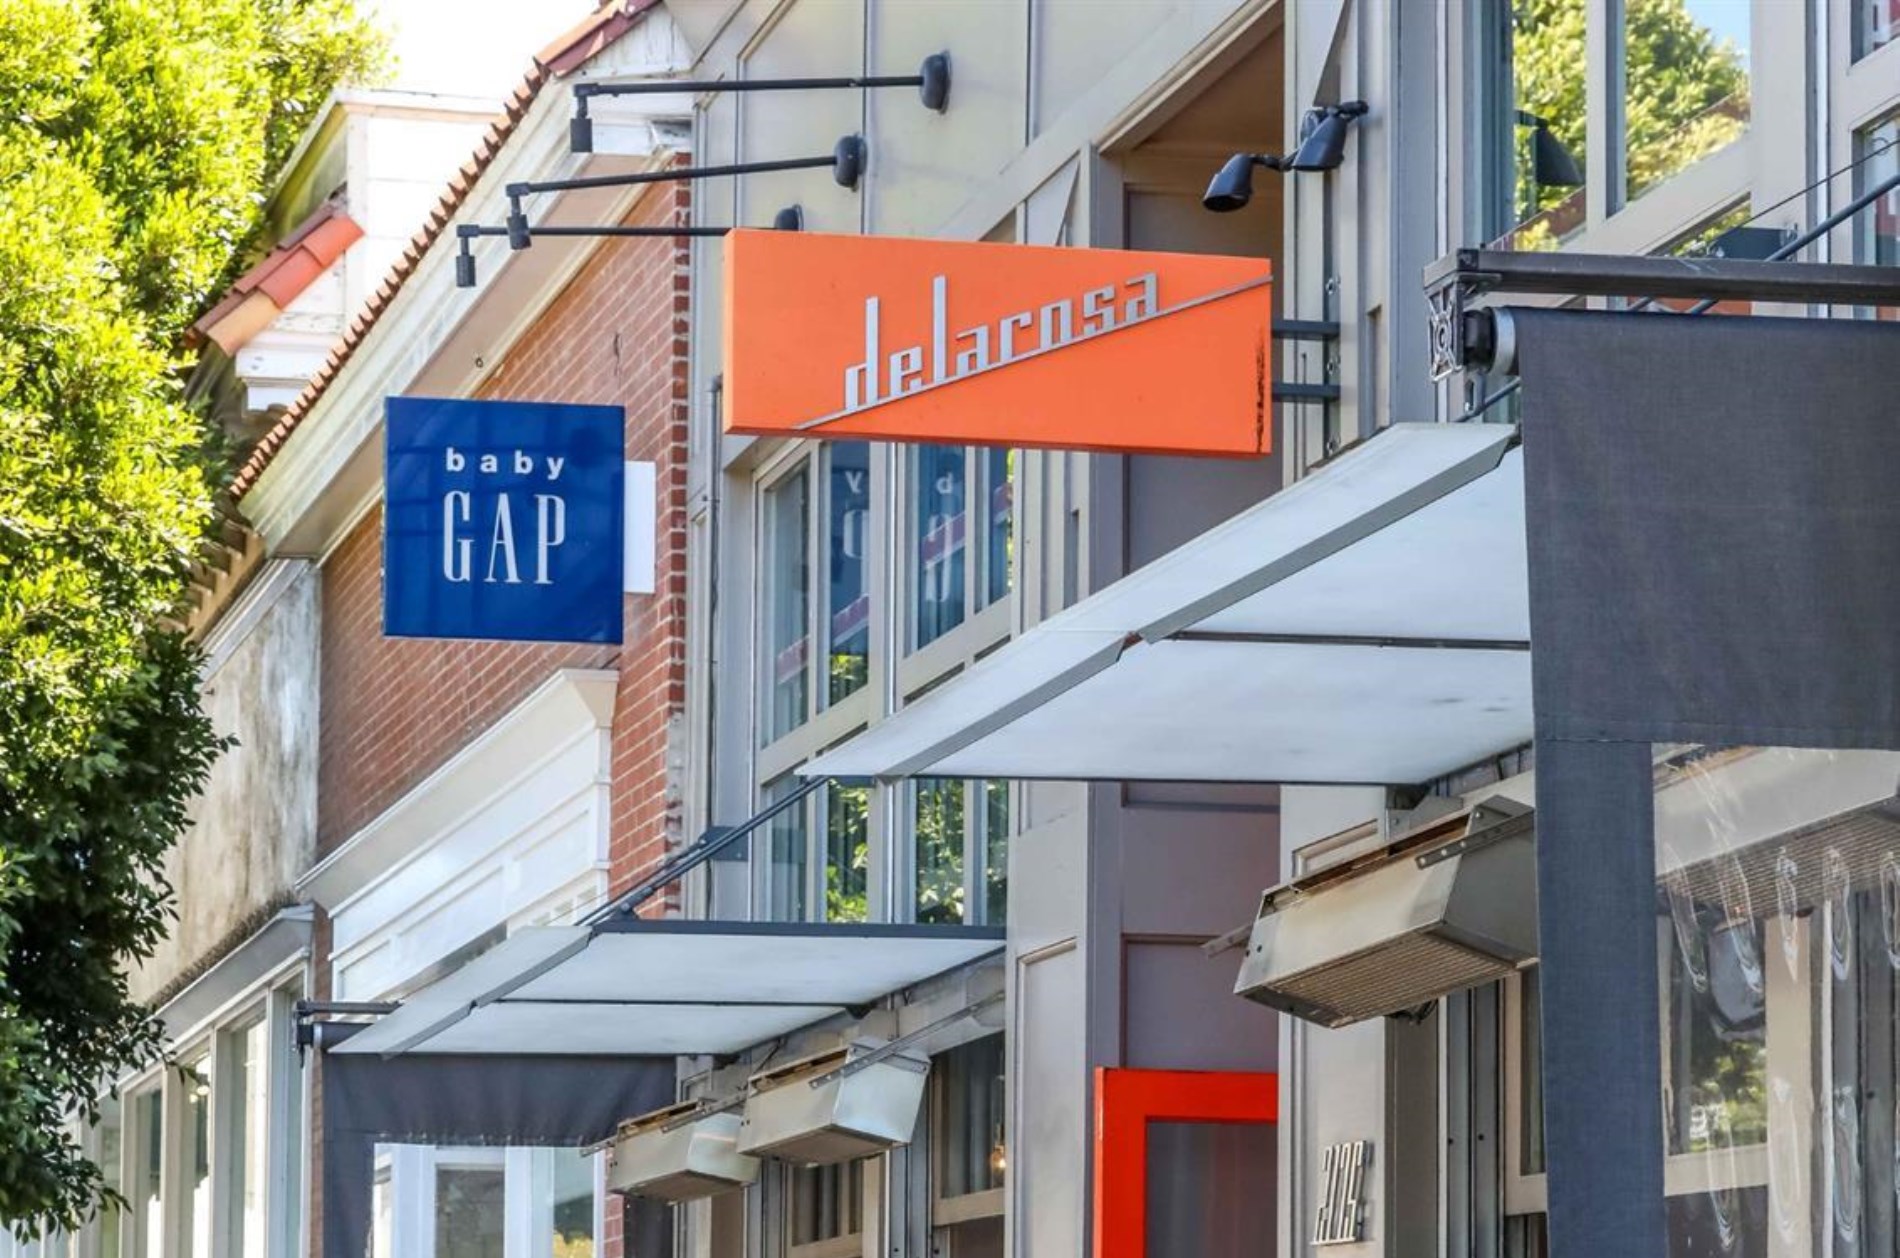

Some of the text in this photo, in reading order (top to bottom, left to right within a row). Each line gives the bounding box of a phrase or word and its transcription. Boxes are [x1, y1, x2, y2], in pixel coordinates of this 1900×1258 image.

[845, 273, 1157, 412] delarosa
[446, 447, 564, 480] baby
[443, 490, 566, 585] GAP
